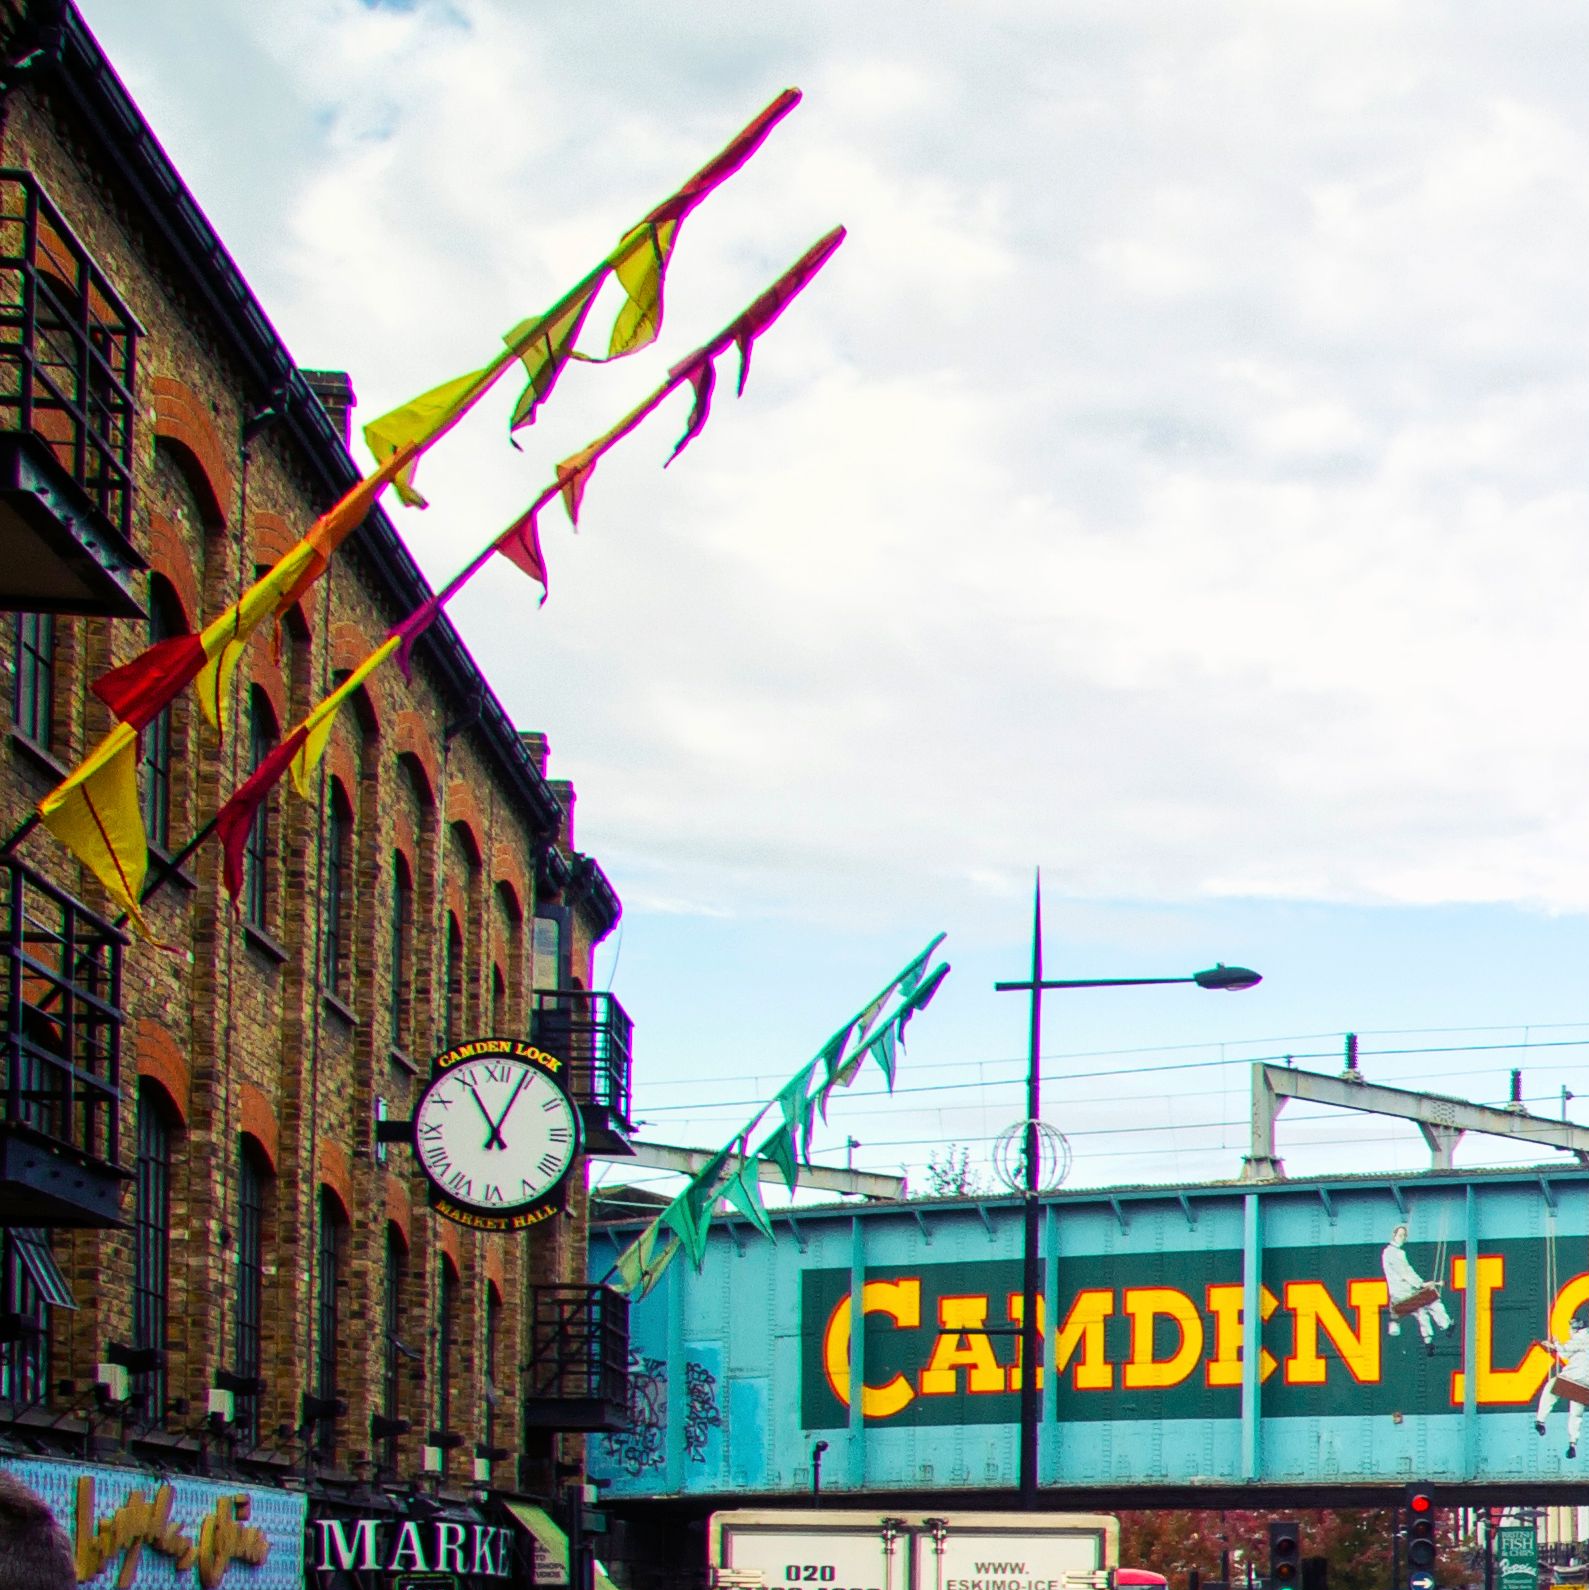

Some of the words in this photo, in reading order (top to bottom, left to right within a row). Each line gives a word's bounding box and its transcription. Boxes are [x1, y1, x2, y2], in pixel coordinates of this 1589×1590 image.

[439, 1040, 512, 1068] CAMDEN
[515, 1043, 563, 1073] LOCK
[434, 1200, 508, 1229] MARKET
[513, 1203, 558, 1229] HALL
[823, 1276, 1388, 1418] CAMDEN
[1501, 1538, 1533, 1550] FISH
[785, 1564, 836, 1582] 020
[975, 1562, 1030, 1575] WWW.
